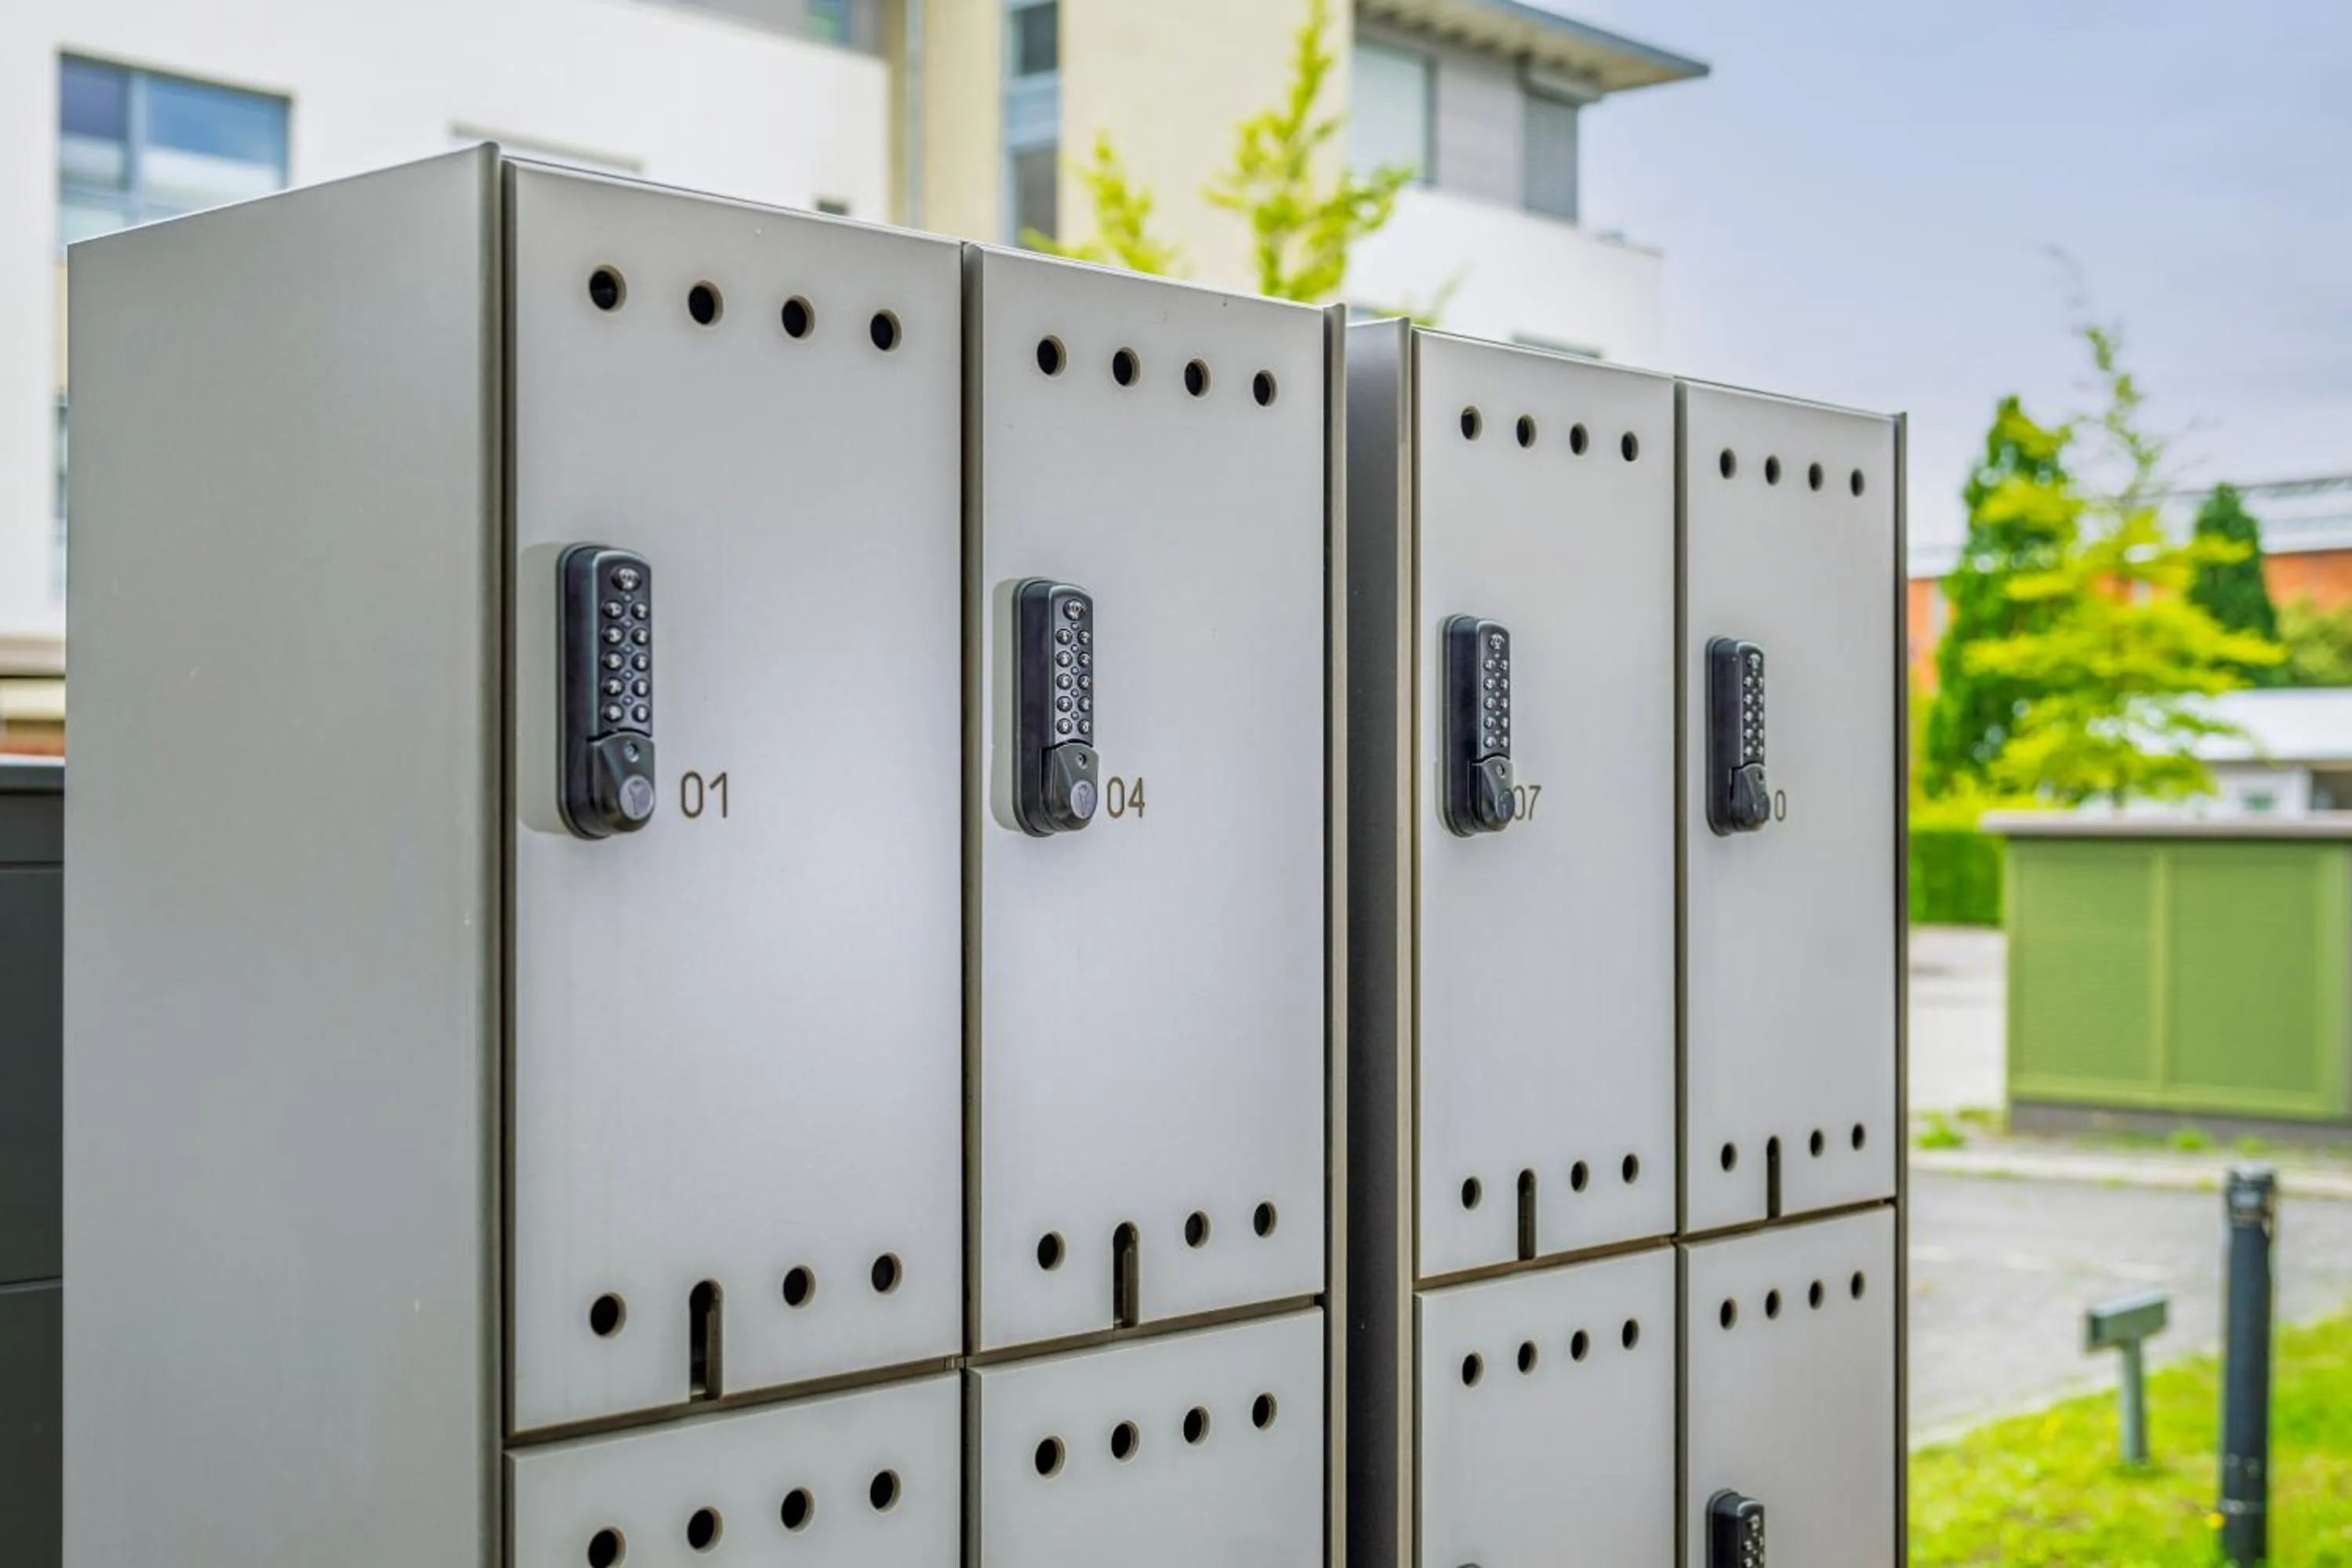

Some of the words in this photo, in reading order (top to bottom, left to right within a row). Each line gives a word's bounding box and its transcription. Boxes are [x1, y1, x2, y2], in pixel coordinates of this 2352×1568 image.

[680, 771, 728, 818] 01
[1106, 776, 1145, 818] 04
[1513, 784, 1541, 822] 07
[1773, 789, 1787, 822] 0
